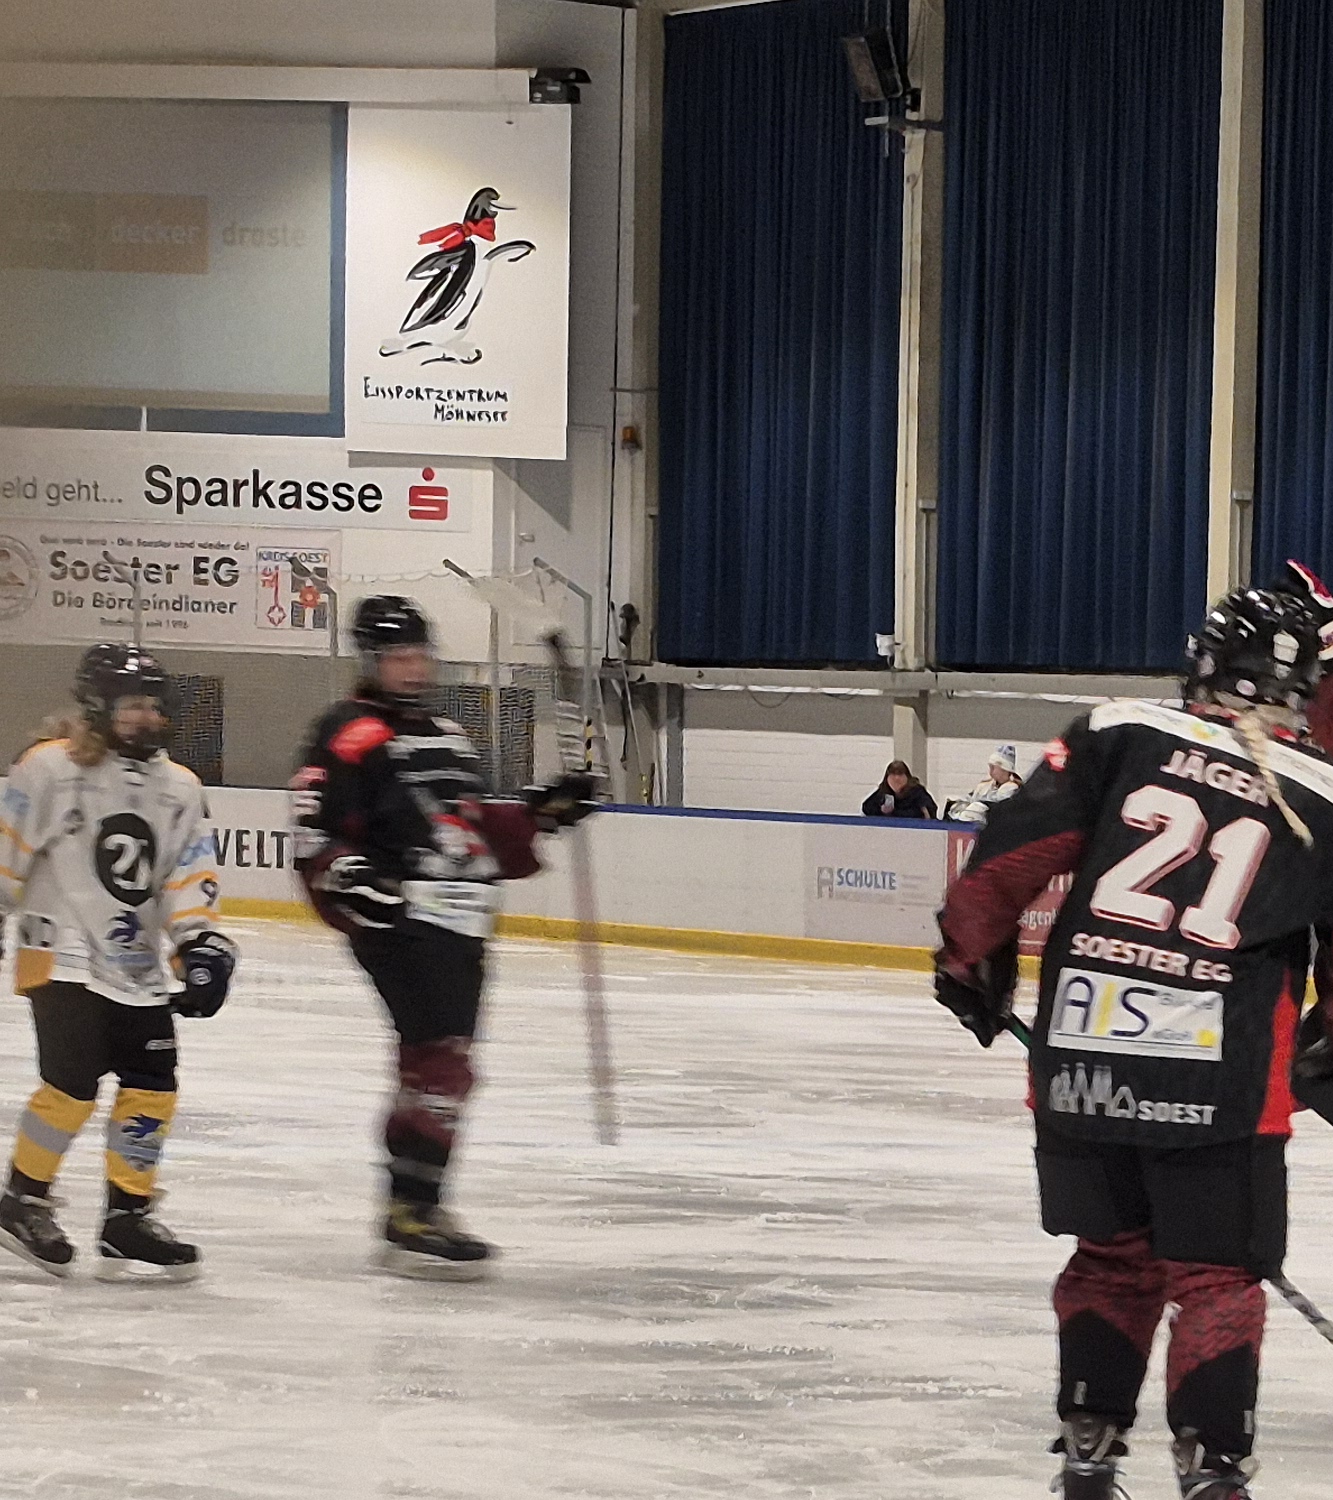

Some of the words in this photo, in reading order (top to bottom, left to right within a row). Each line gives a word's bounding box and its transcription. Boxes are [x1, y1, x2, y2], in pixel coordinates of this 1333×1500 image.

[0, 476, 37, 500] eld
[144, 464, 383, 515] Sparkasse
[193, 556, 240, 588] EG
[212, 828, 290, 869] VELT
[1089, 784, 1272, 950] 21
[837, 867, 897, 891] SCHULTE
[1069, 932, 1190, 977] SOESTER
[1137, 1099, 1219, 1126] SOEST
